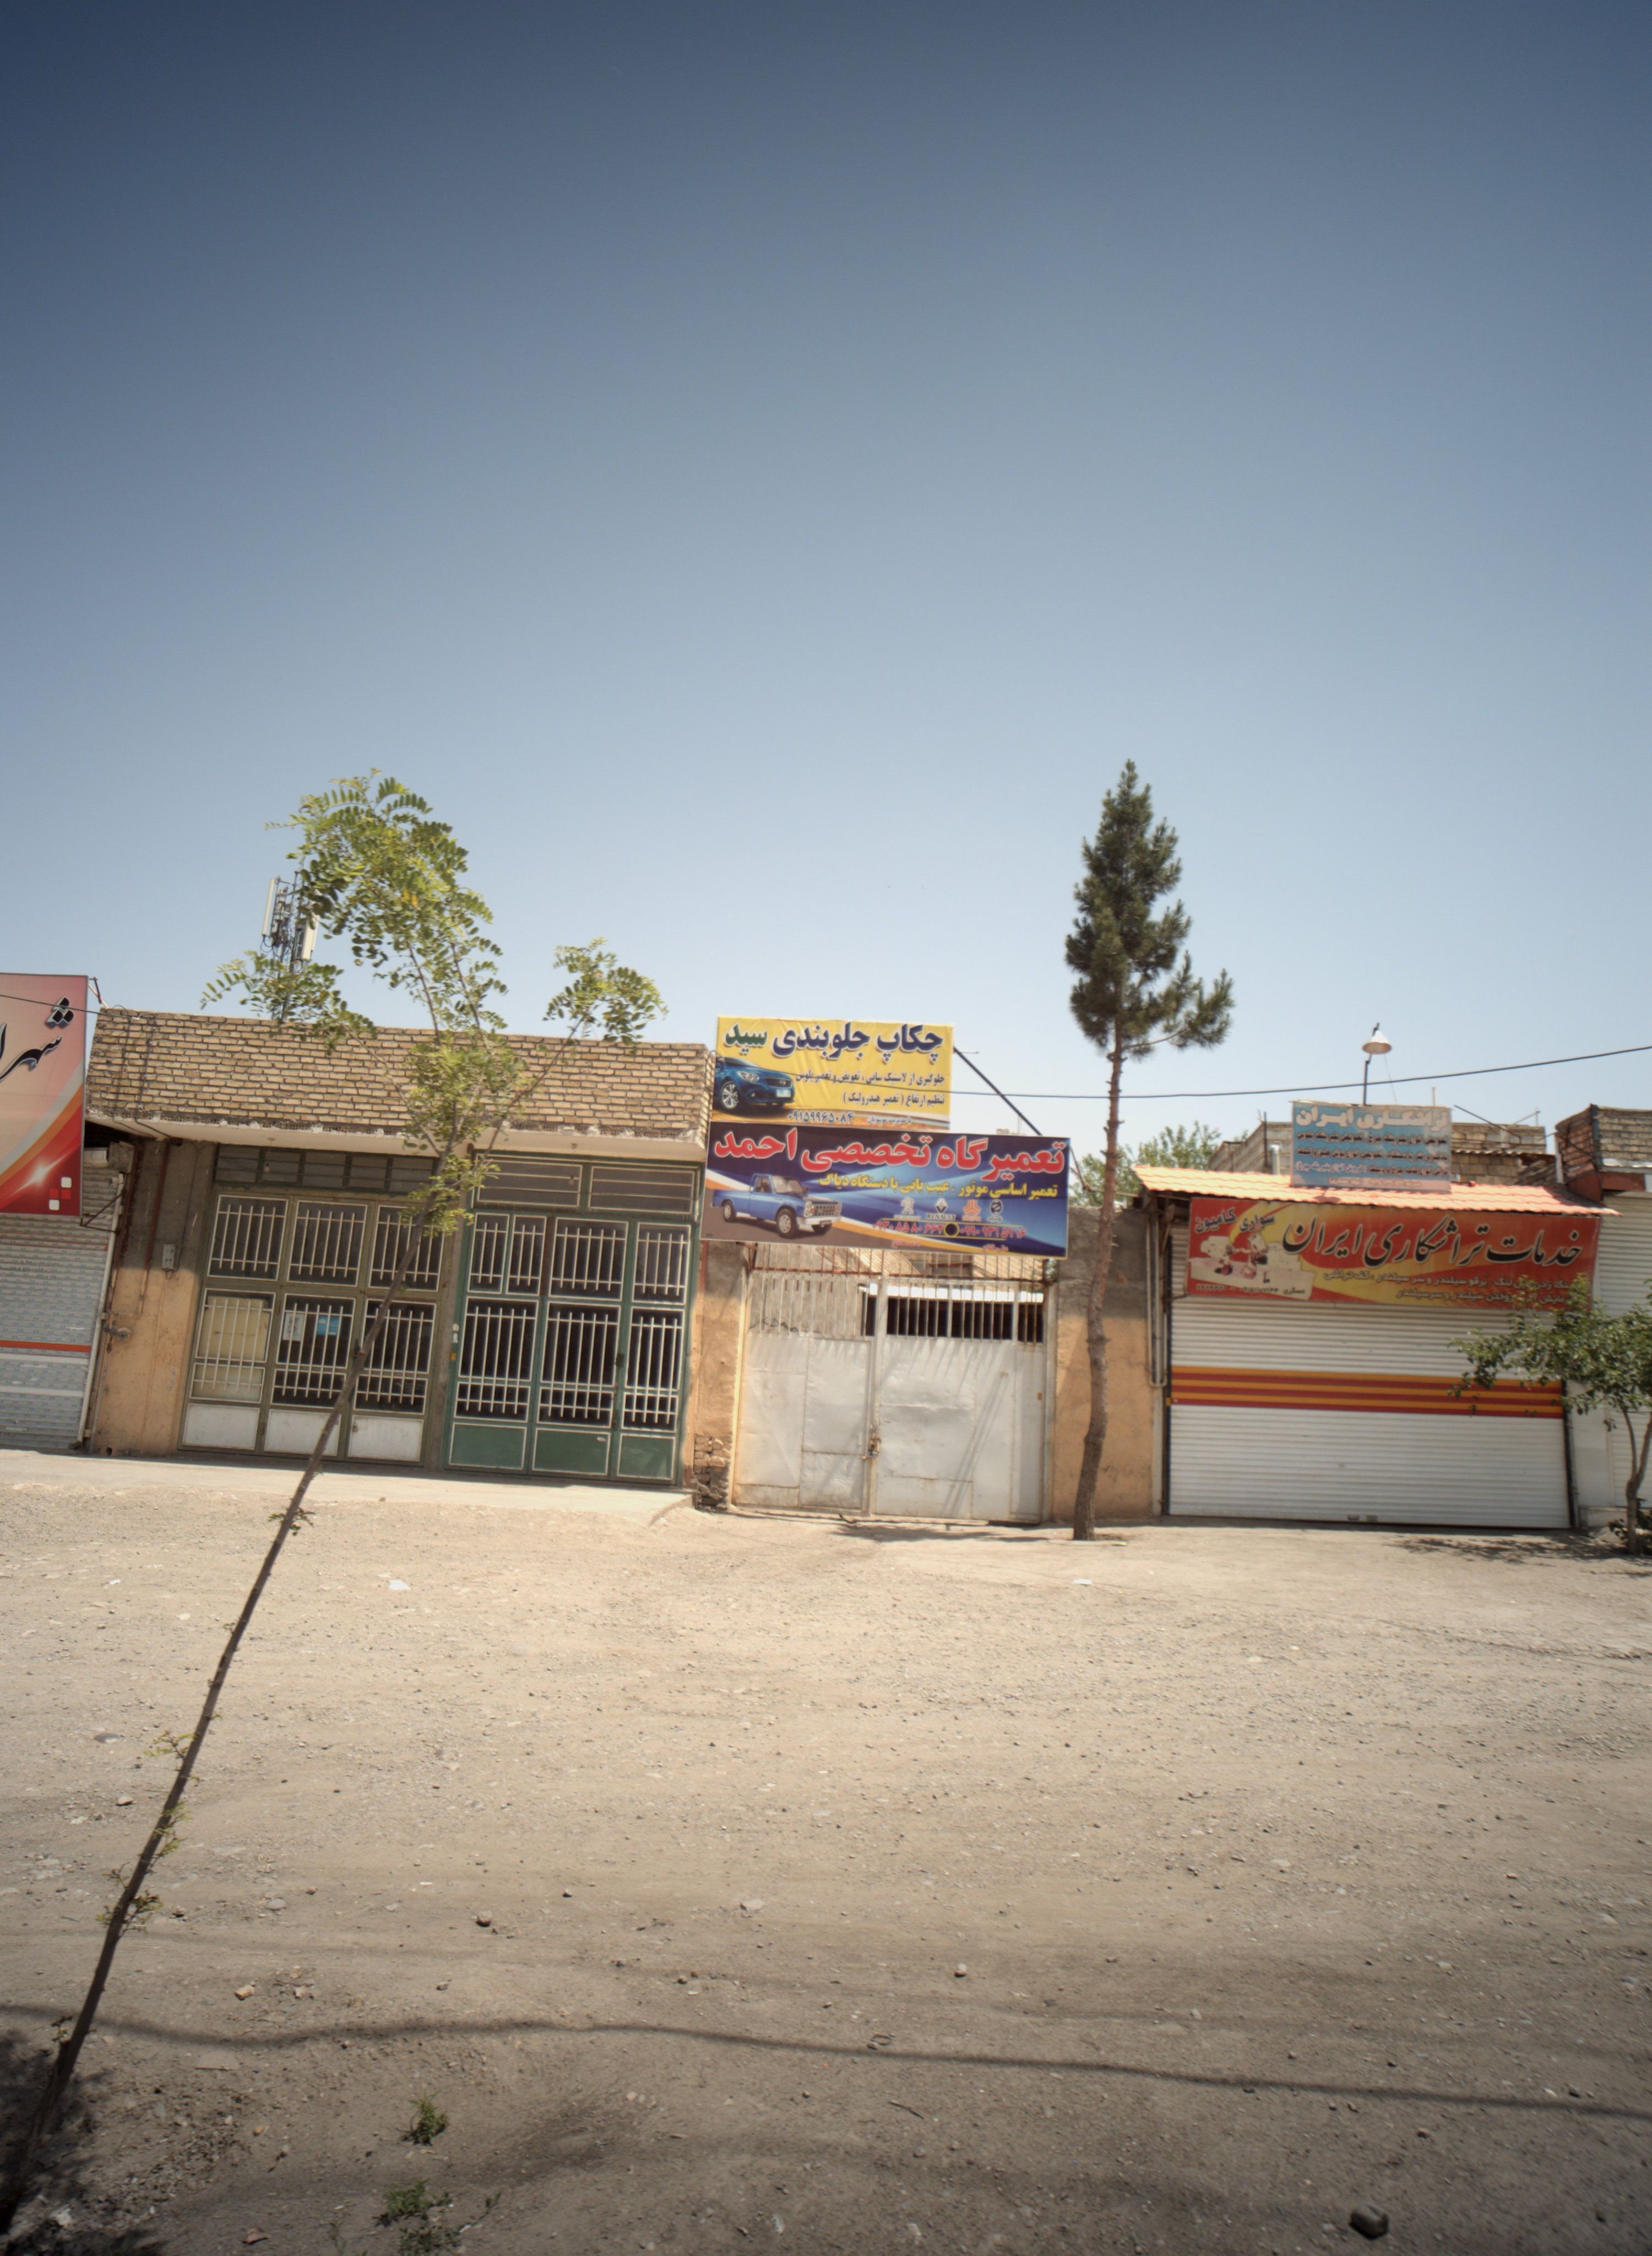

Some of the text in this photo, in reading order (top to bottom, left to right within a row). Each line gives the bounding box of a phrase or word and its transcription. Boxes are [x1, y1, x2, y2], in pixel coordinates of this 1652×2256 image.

[725, 1022, 943, 1064] چکاپ جلوبندی سید
[909, 1073, 915, 1085] از
[1296, 1105, 1354, 1127] ایران
[714, 1127, 798, 1159] احمد
[801, 1133, 932, 1172] تخصصی
[819, 1173, 849, 1187] دیاگ
[851, 1176, 889, 1189] دستگاه
[890, 1178, 898, 1190] با
[958, 1180, 988, 1197] موتور
[990, 1183, 1026, 1198] اساسی
[1028, 1184, 1058, 1200] تعمیر
[1195, 1207, 1275, 1233] سواری کامیون
[1283, 1214, 1582, 1268] خدمات تراشکاری ایران
[1433, 1275, 1468, 1286] سیلندر
